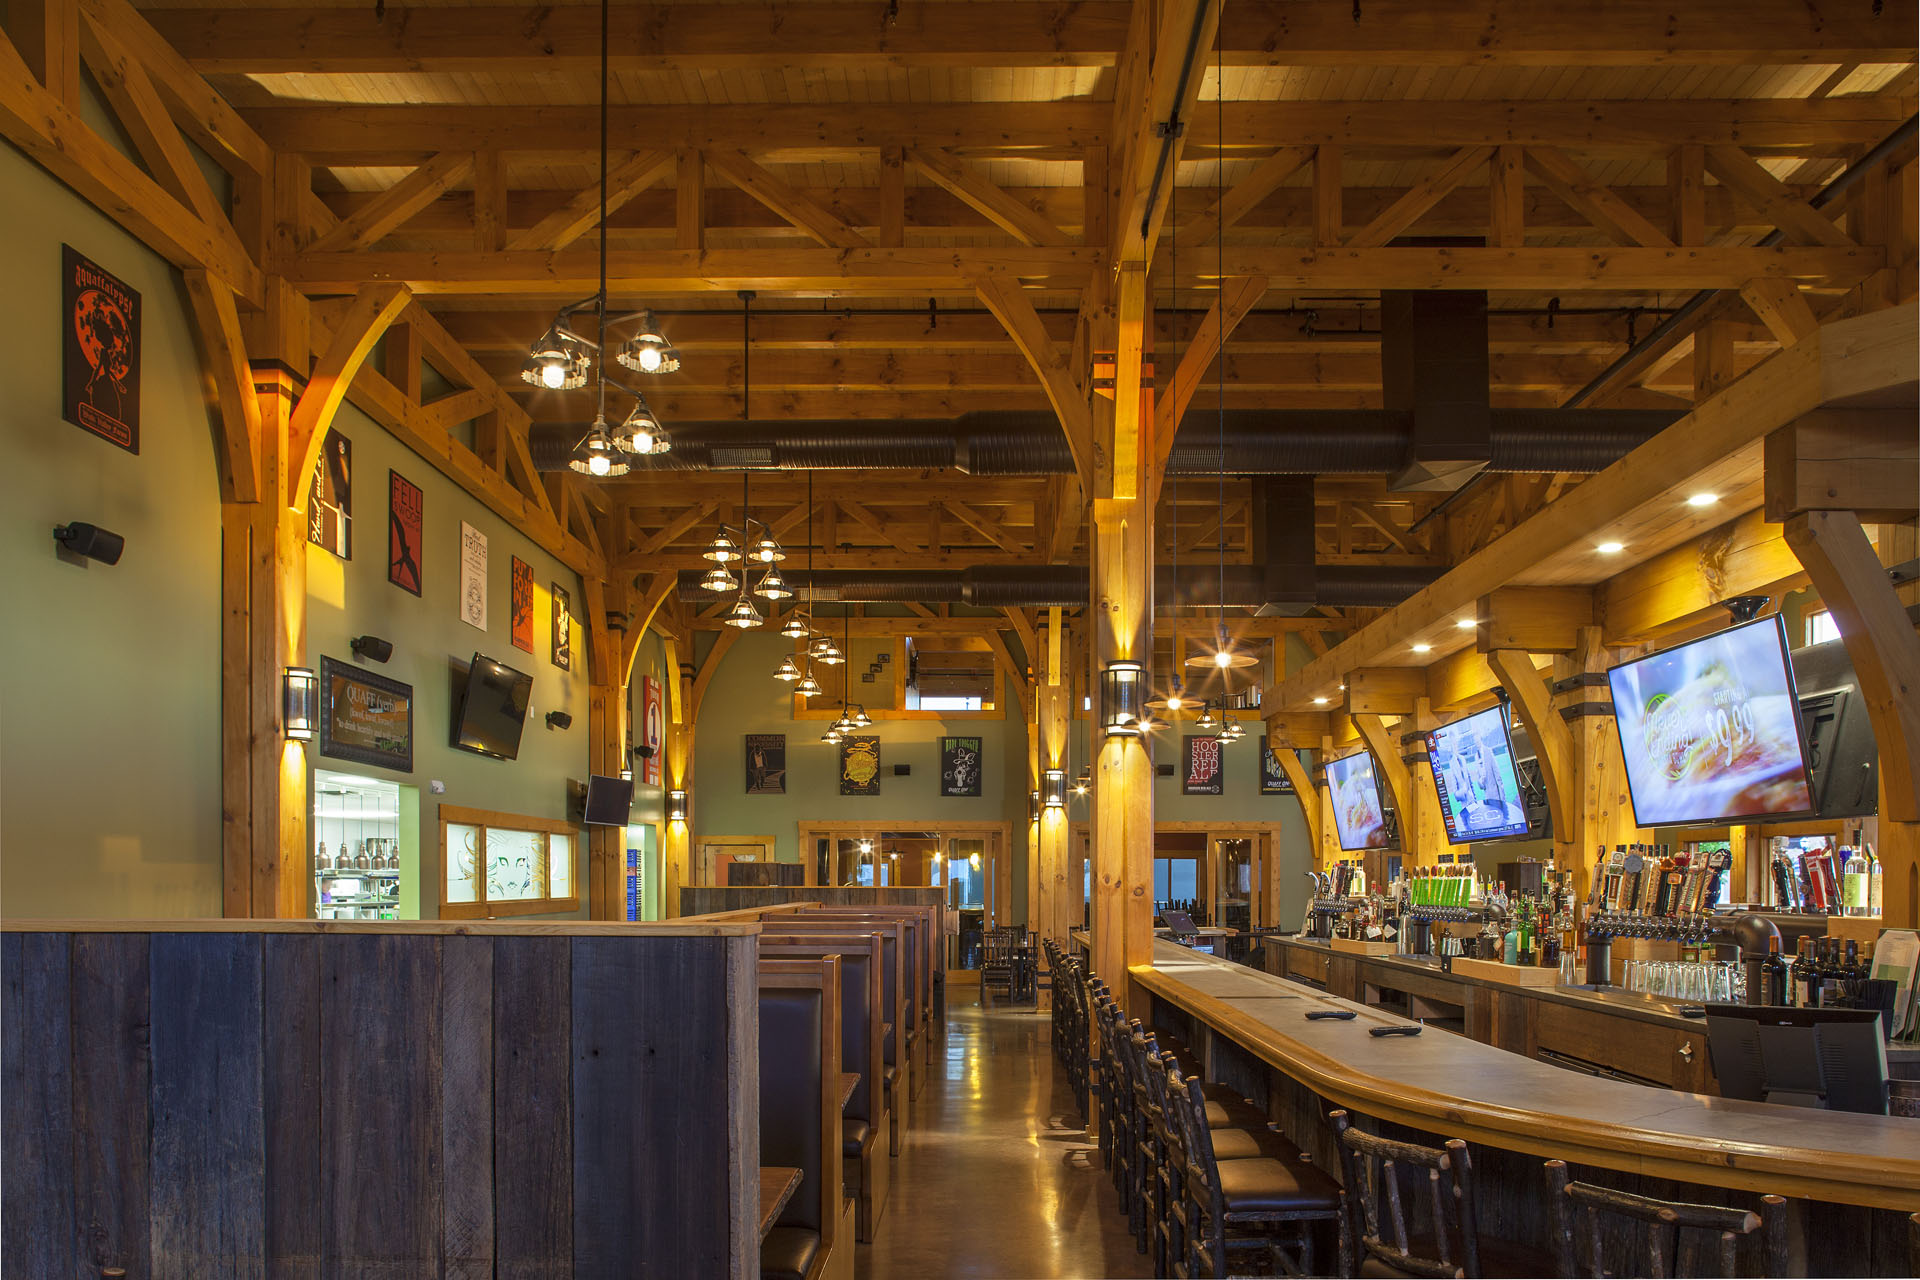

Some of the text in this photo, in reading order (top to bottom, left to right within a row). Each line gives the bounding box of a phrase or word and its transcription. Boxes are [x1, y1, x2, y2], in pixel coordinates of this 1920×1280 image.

[394, 477, 420, 514] FELL
[464, 533, 487, 560] TRUTH
[346, 685, 377, 707] QUAFF
[1191, 741, 1219, 752] HOO
[1191, 751, 1219, 760] SIER
[1191, 760, 1219, 770] RED
[1469, 808, 1501, 824] SC
